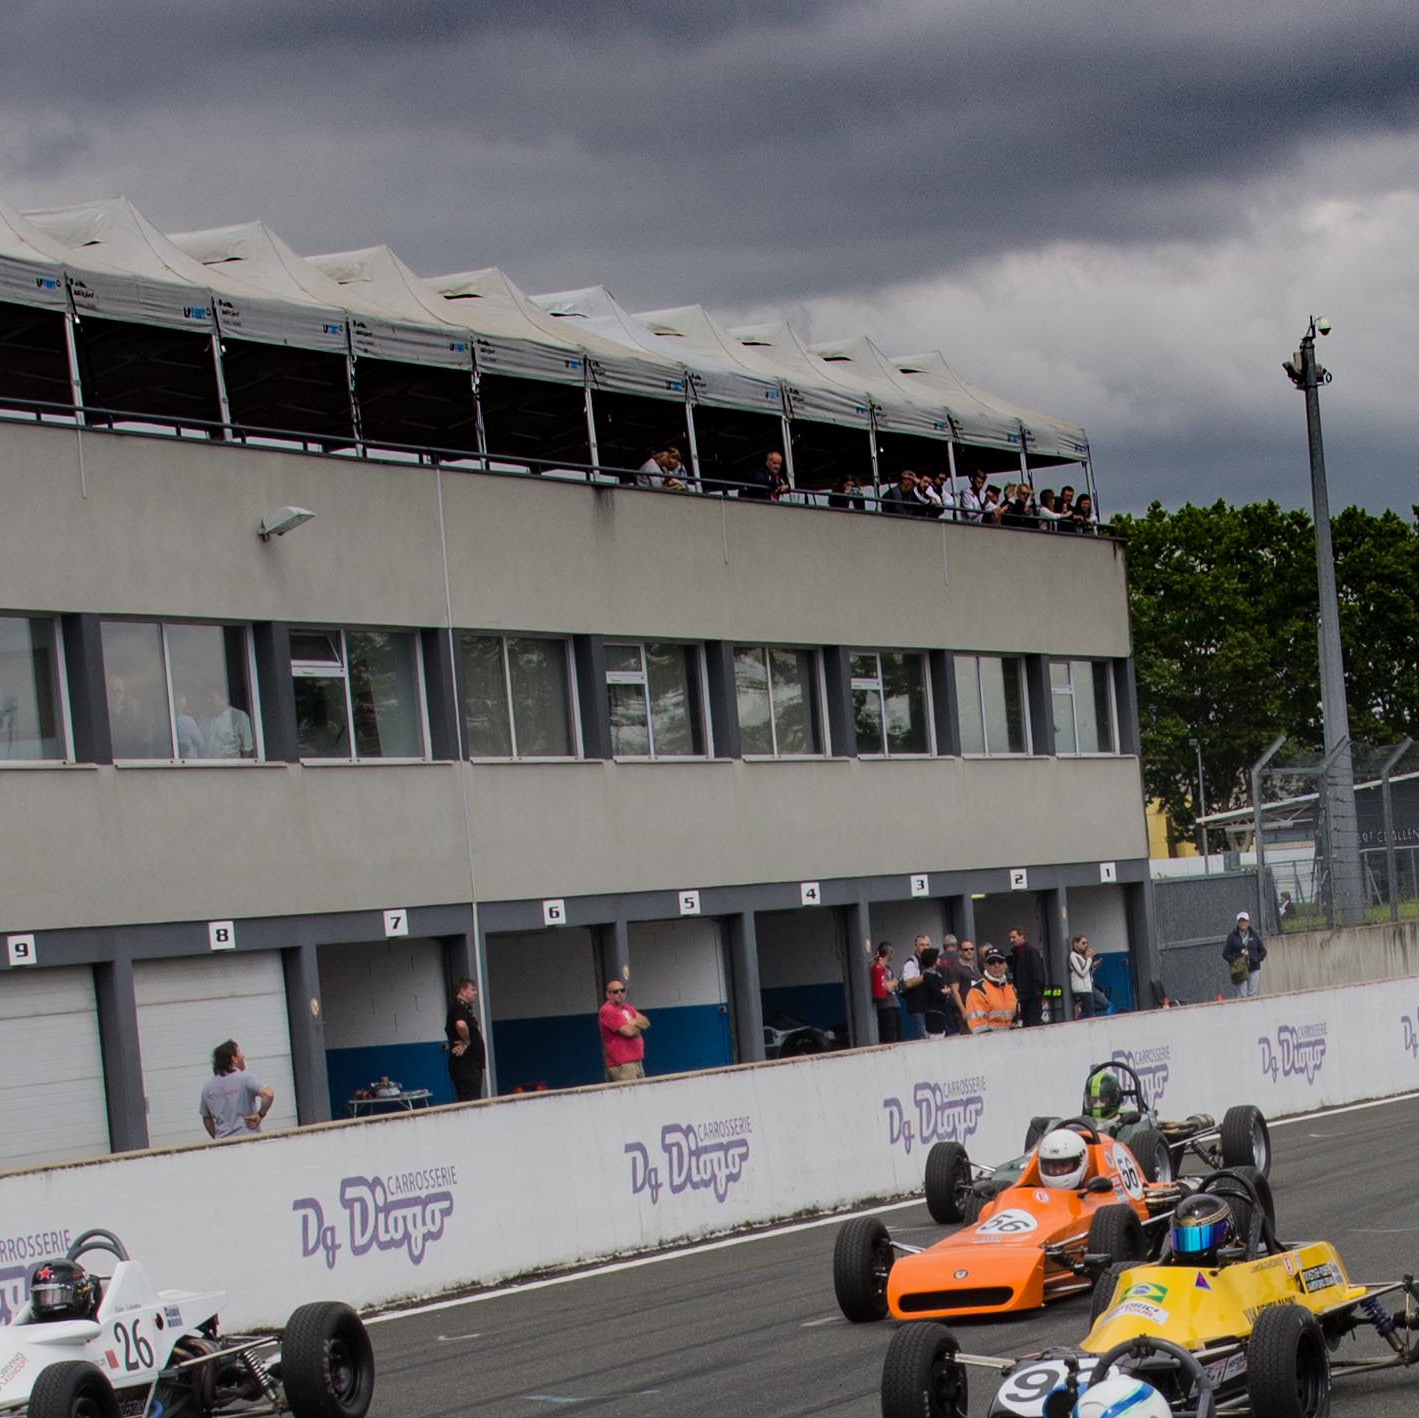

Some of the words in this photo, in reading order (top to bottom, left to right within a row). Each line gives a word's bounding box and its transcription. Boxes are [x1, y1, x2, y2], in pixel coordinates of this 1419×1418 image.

[684, 897, 695, 909] 5
[805, 889, 817, 900] 4
[548, 906, 560, 919] 6
[390, 917, 402, 929] 7
[215, 928, 229, 942] 8
[14, 942, 29, 957] 9
[697, 1116, 752, 1142] CARROSSERIE
[661, 1123, 750, 1203] Diogo
[1118, 1155, 1139, 1190] 56
[387, 1165, 458, 1196] CARROSSERIE
[340, 1175, 454, 1265] Diogo
[982, 1213, 1031, 1233] 56
[113, 1318, 154, 1372] 26
